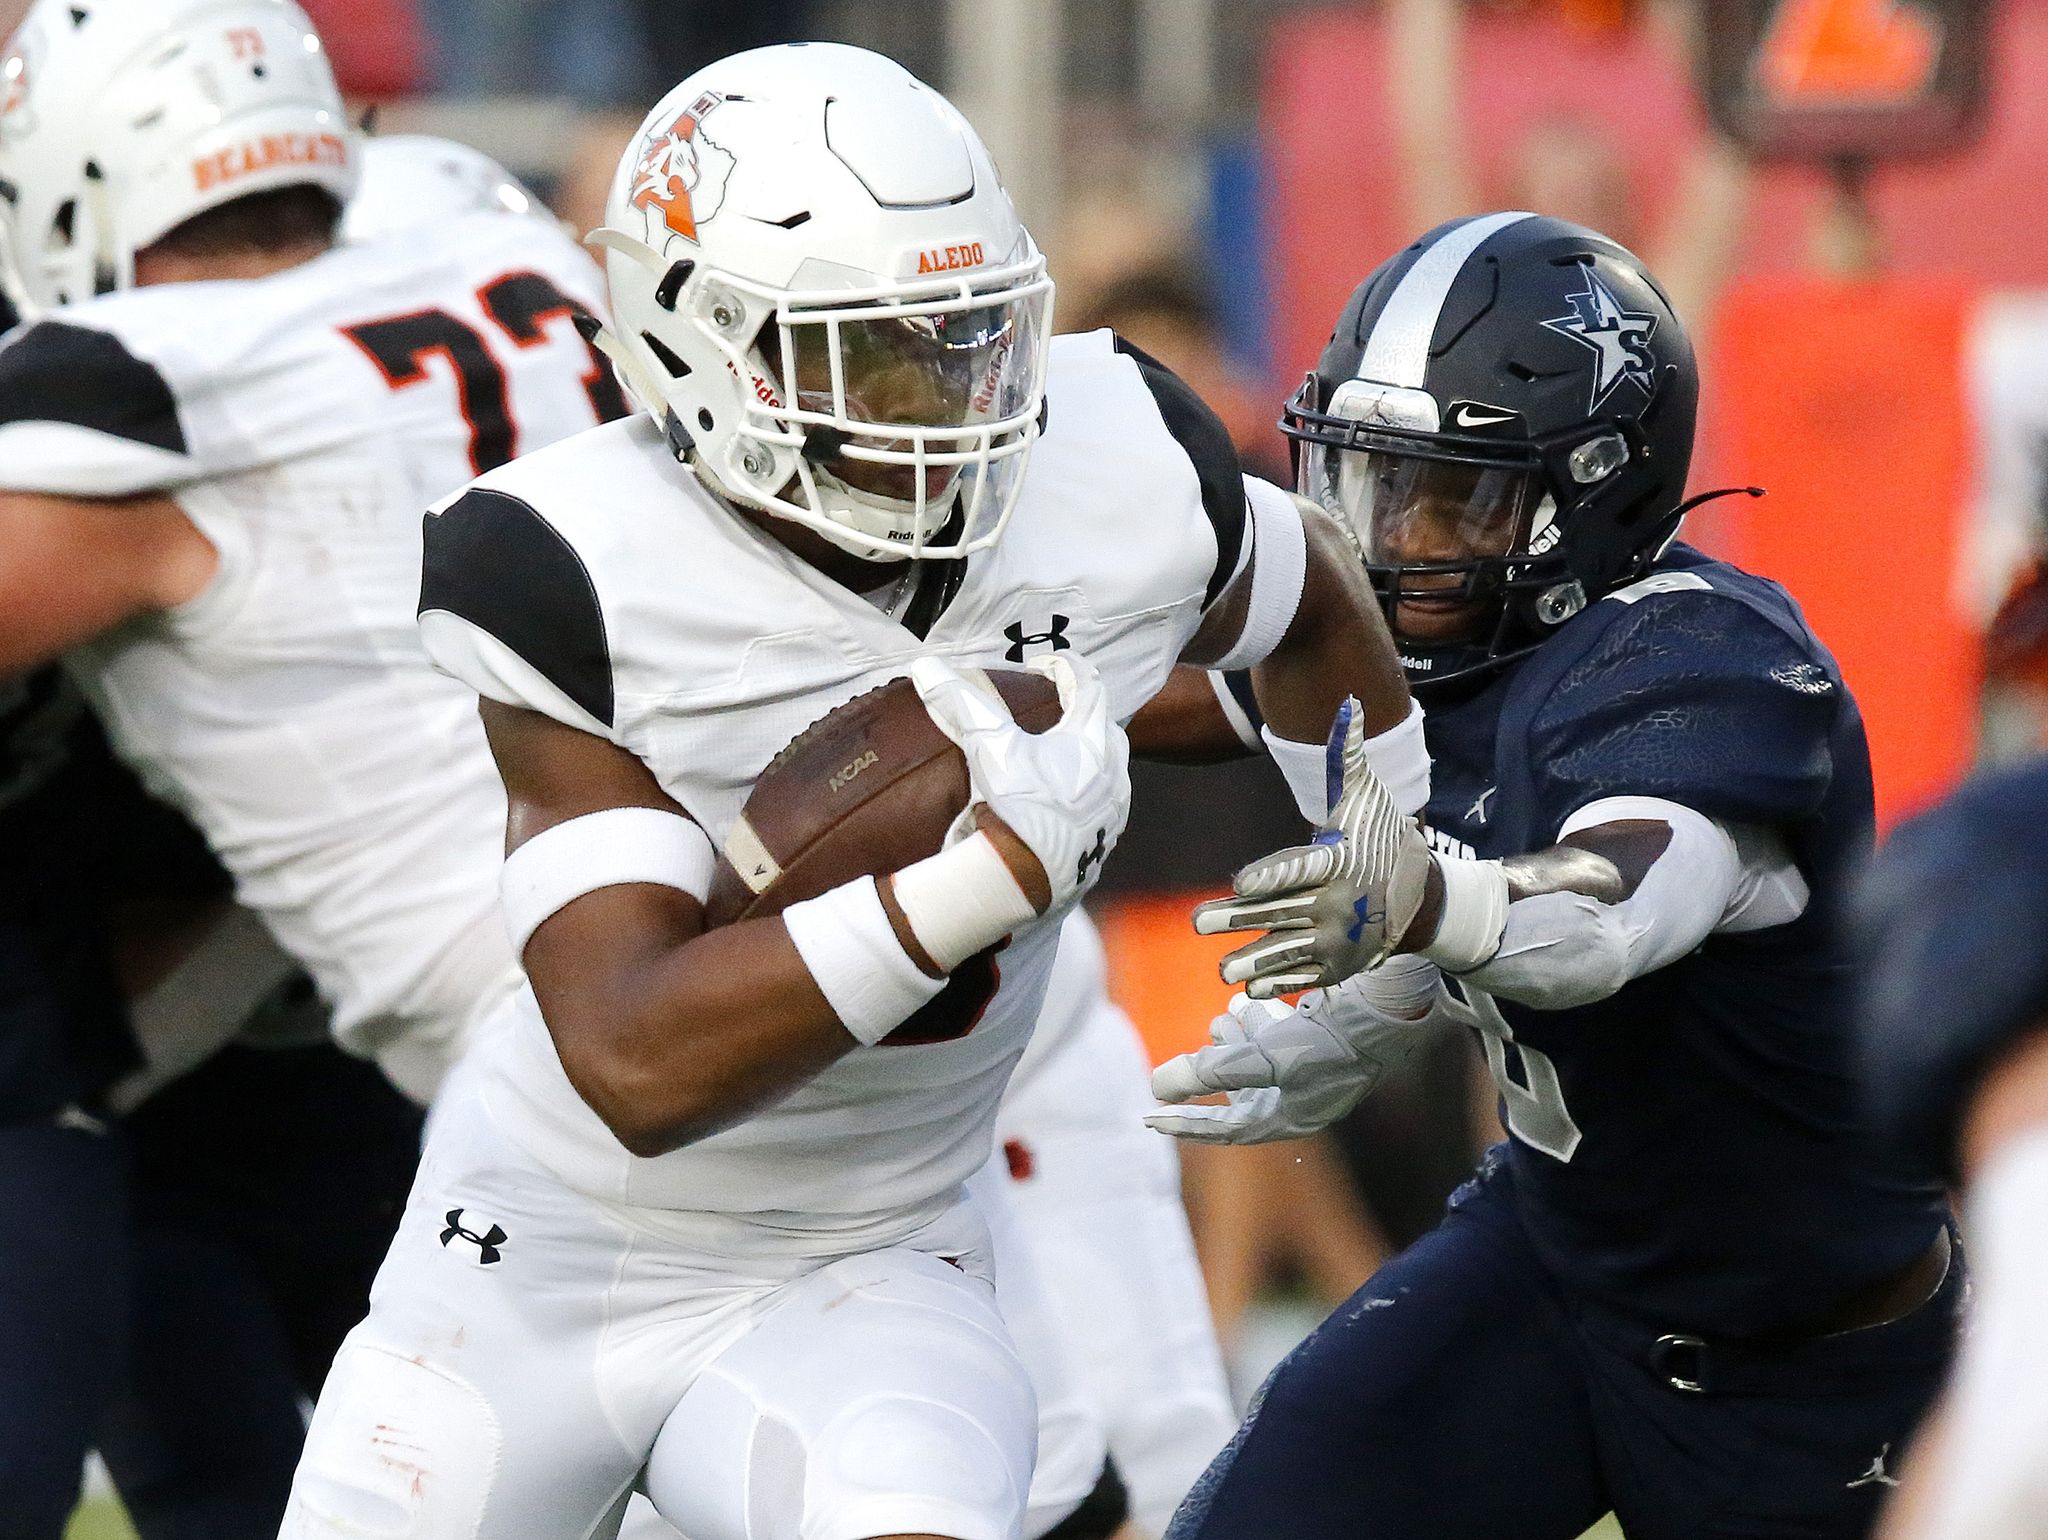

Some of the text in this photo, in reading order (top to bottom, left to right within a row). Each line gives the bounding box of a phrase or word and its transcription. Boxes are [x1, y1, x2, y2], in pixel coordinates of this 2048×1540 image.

[192, 132, 347, 191] BEARCATS
[917, 242, 985, 274] ALEDO
[887, 529, 932, 540] Ridll
[1396, 655, 1433, 670] ddell
[828, 750, 880, 793] NCAA
